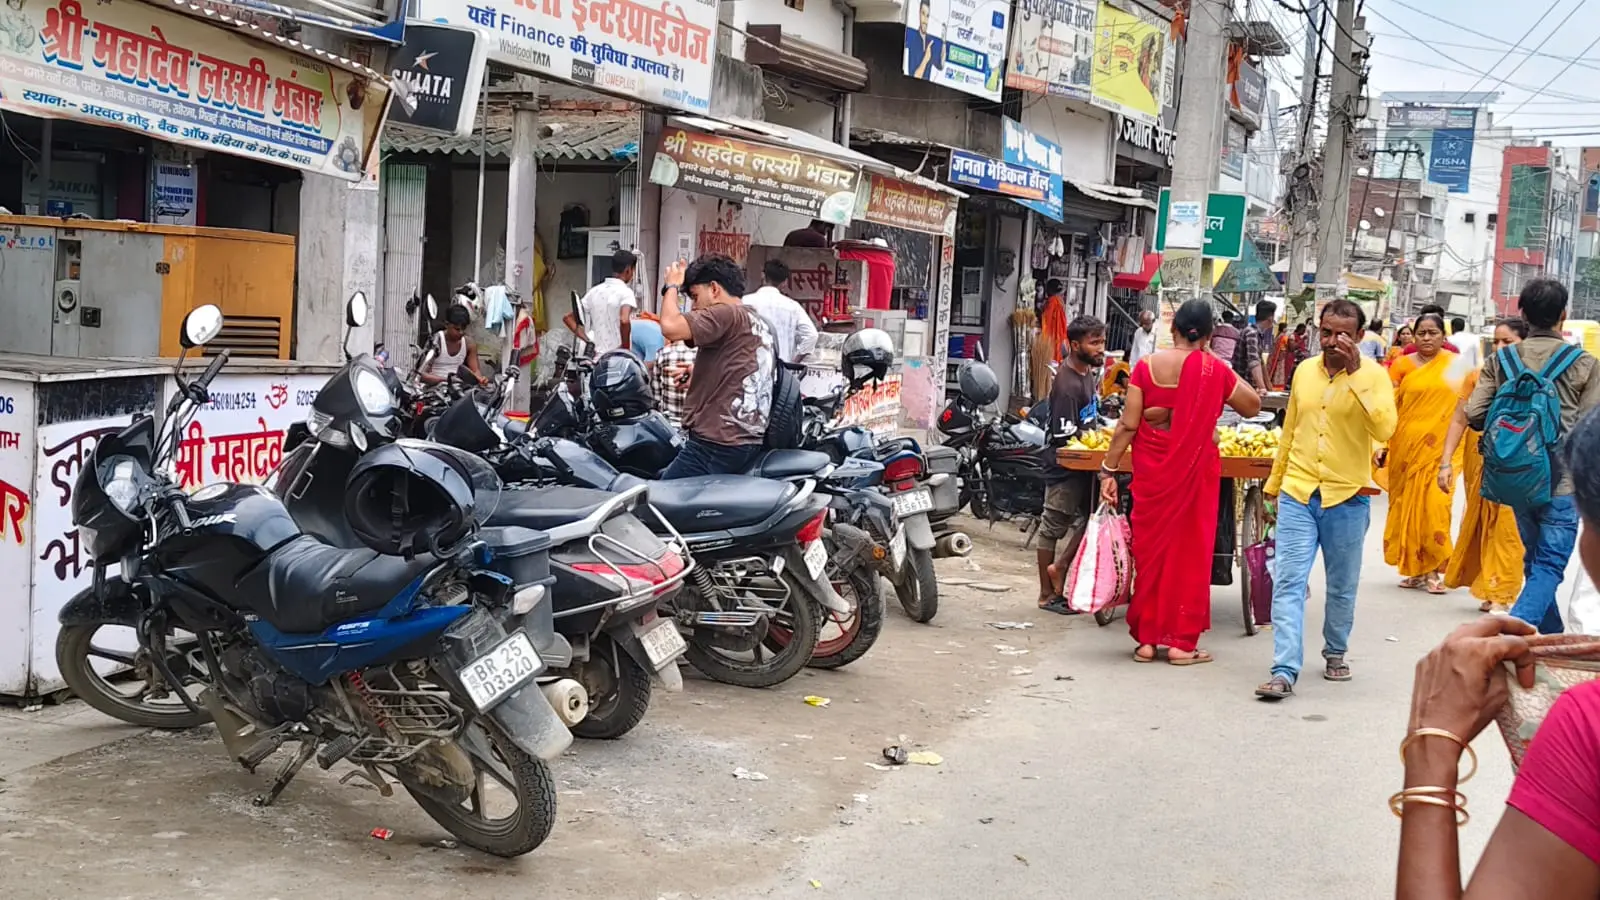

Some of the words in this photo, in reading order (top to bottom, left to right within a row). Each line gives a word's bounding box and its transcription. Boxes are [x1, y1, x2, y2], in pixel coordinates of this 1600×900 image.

[500, 13, 566, 49] Finance
[569, 35, 588, 56] की
[590, 43, 629, 64] सुविधा
[39, 0, 88, 69] श्री
[93, 25, 193, 98] महादेव
[198, 56, 271, 118] लस्सी
[273, 70, 323, 134] भंडार
[499, 38, 532, 60] Whirlpool
[533, 50, 551, 68] TATA
[572, 64, 595, 79] SONY
[604, 73, 636, 92] ONEPLUS
[181, 126, 209, 141] ऑफ
[211, 132, 244, 149] इंडिया
[245, 140, 258, 152] के
[259, 143, 277, 157] गेट
[278, 148, 290, 160] के
[291, 152, 312, 165] पास
[663, 131, 687, 155] श्री
[691, 140, 748, 167] सहदेव
[752, 152, 802, 179] लस्सी
[806, 159, 855, 189] भंडार
[1433, 157, 1467, 166] KISNA
[49, 180, 99, 195] DAIKIN
[952, 155, 986, 178] जनता
[987, 158, 1028, 187] मेडिकल
[209, 416, 285, 484] महादेव
[473, 657, 498, 682] BR
[500, 639, 523, 665] 25
[483, 656, 533, 697] D3340
